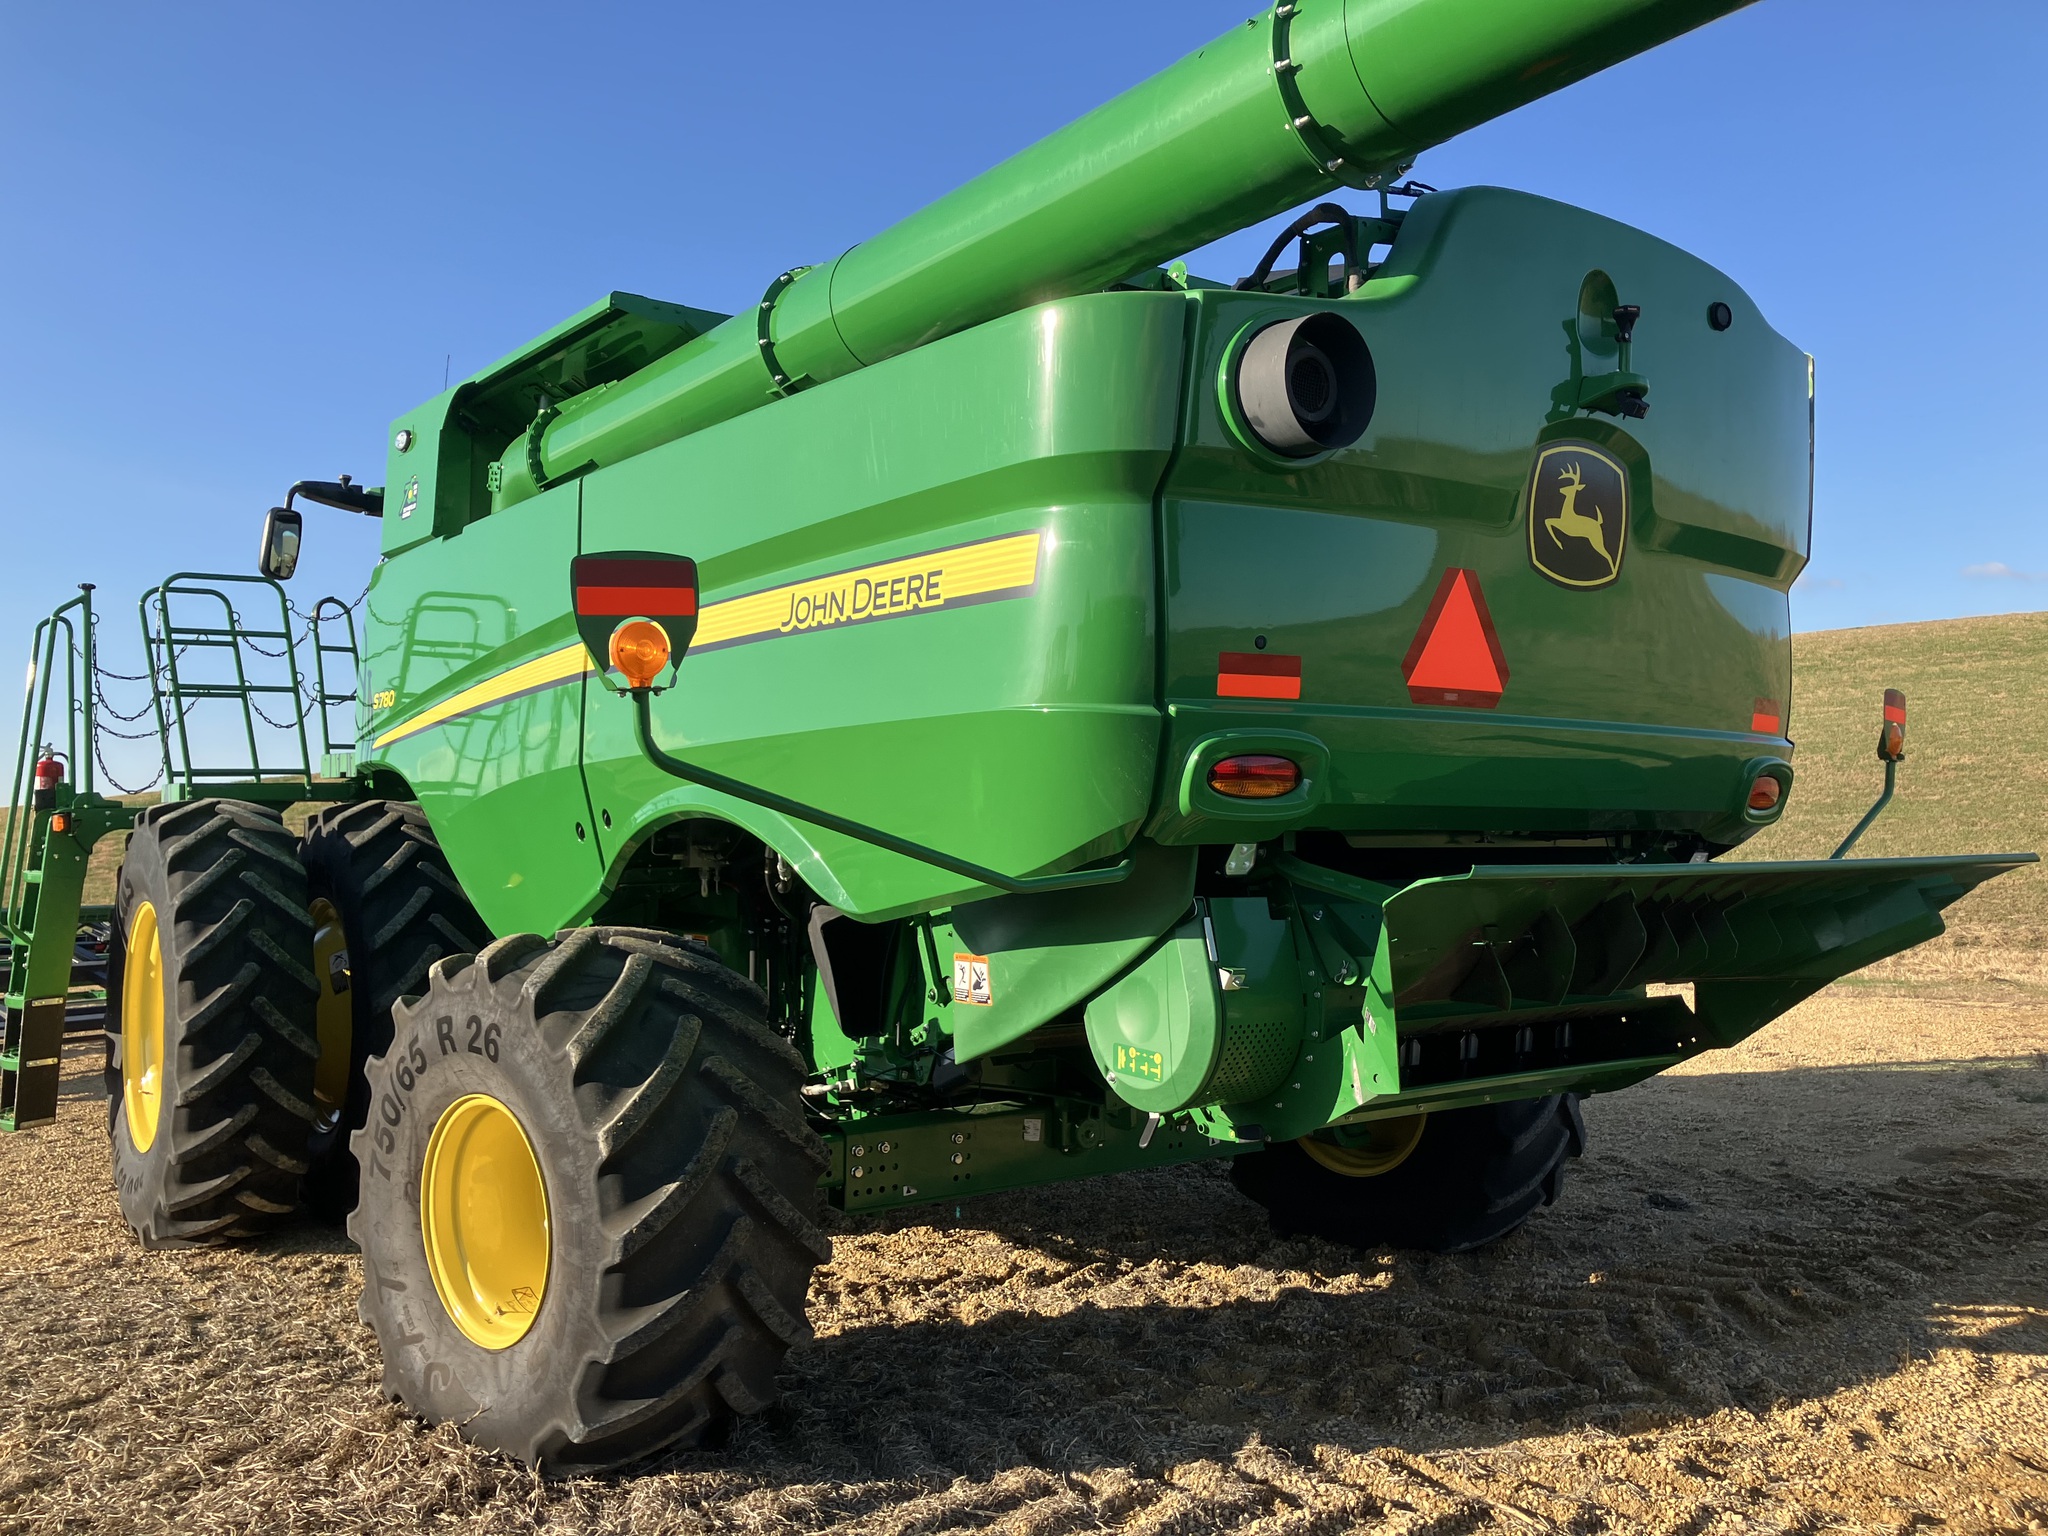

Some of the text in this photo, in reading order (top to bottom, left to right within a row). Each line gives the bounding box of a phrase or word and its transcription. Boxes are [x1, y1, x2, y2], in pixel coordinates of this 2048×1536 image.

[781, 569, 943, 628] JOHN DEERE
[373, 690, 395, 710] S780
[369, 1014, 502, 1183] 750/65 R 26
